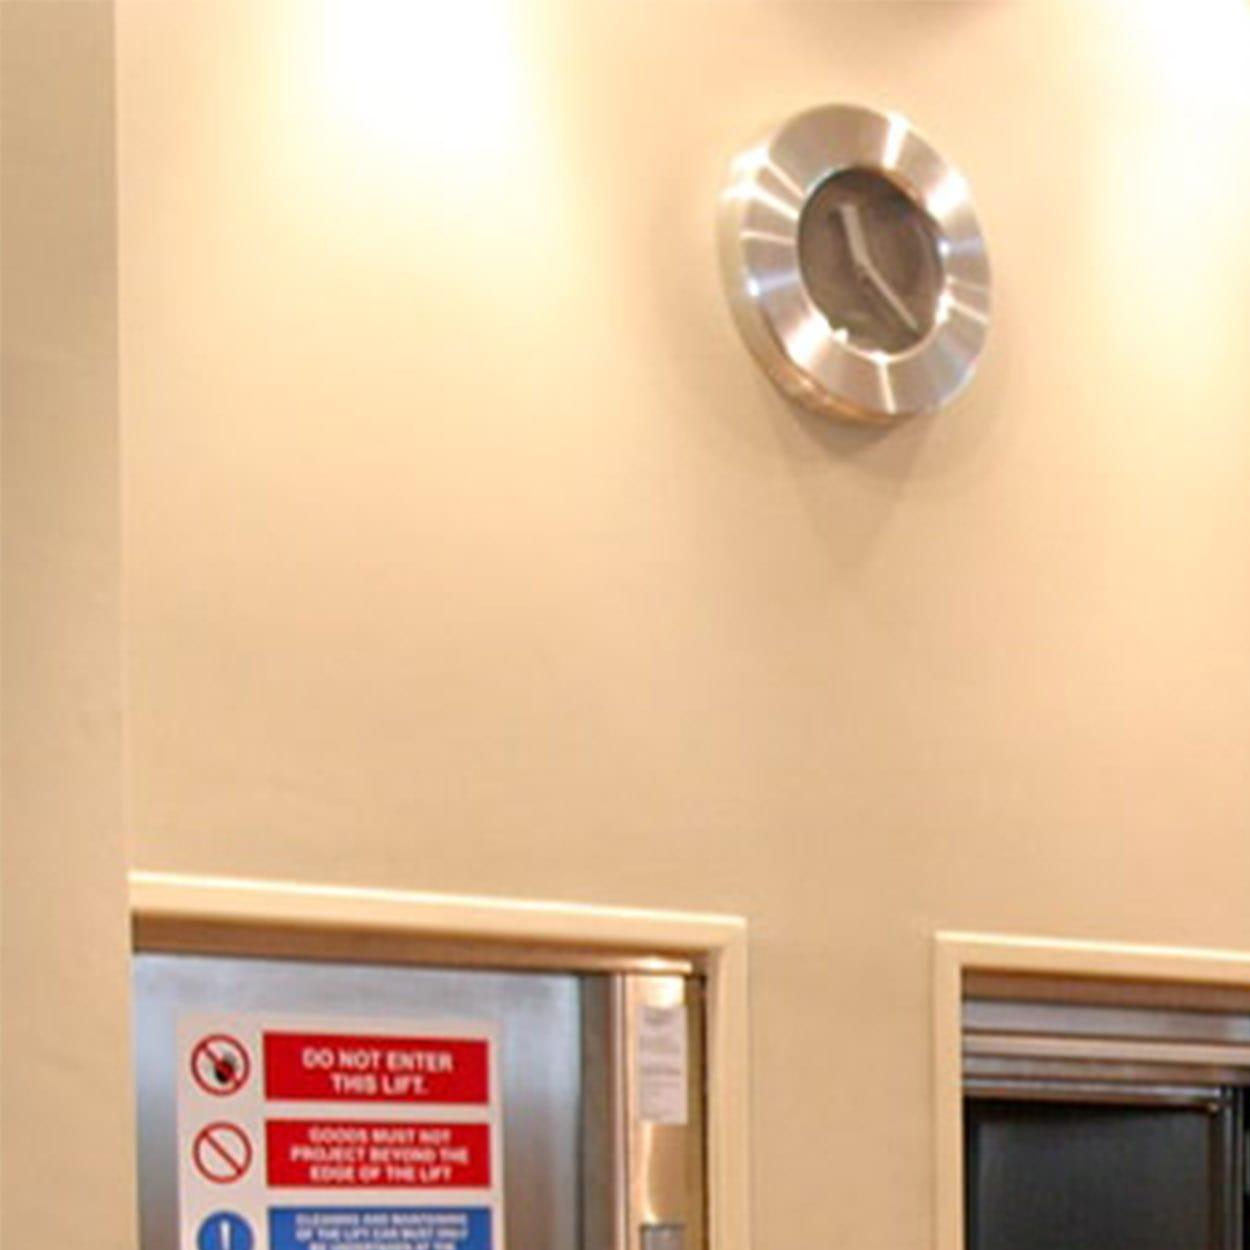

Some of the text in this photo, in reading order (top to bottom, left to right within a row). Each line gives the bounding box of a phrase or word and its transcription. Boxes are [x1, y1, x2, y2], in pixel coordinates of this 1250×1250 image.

[303, 1047, 453, 1072] DO NOT ENTER
[331, 1073, 378, 1095] THIS
